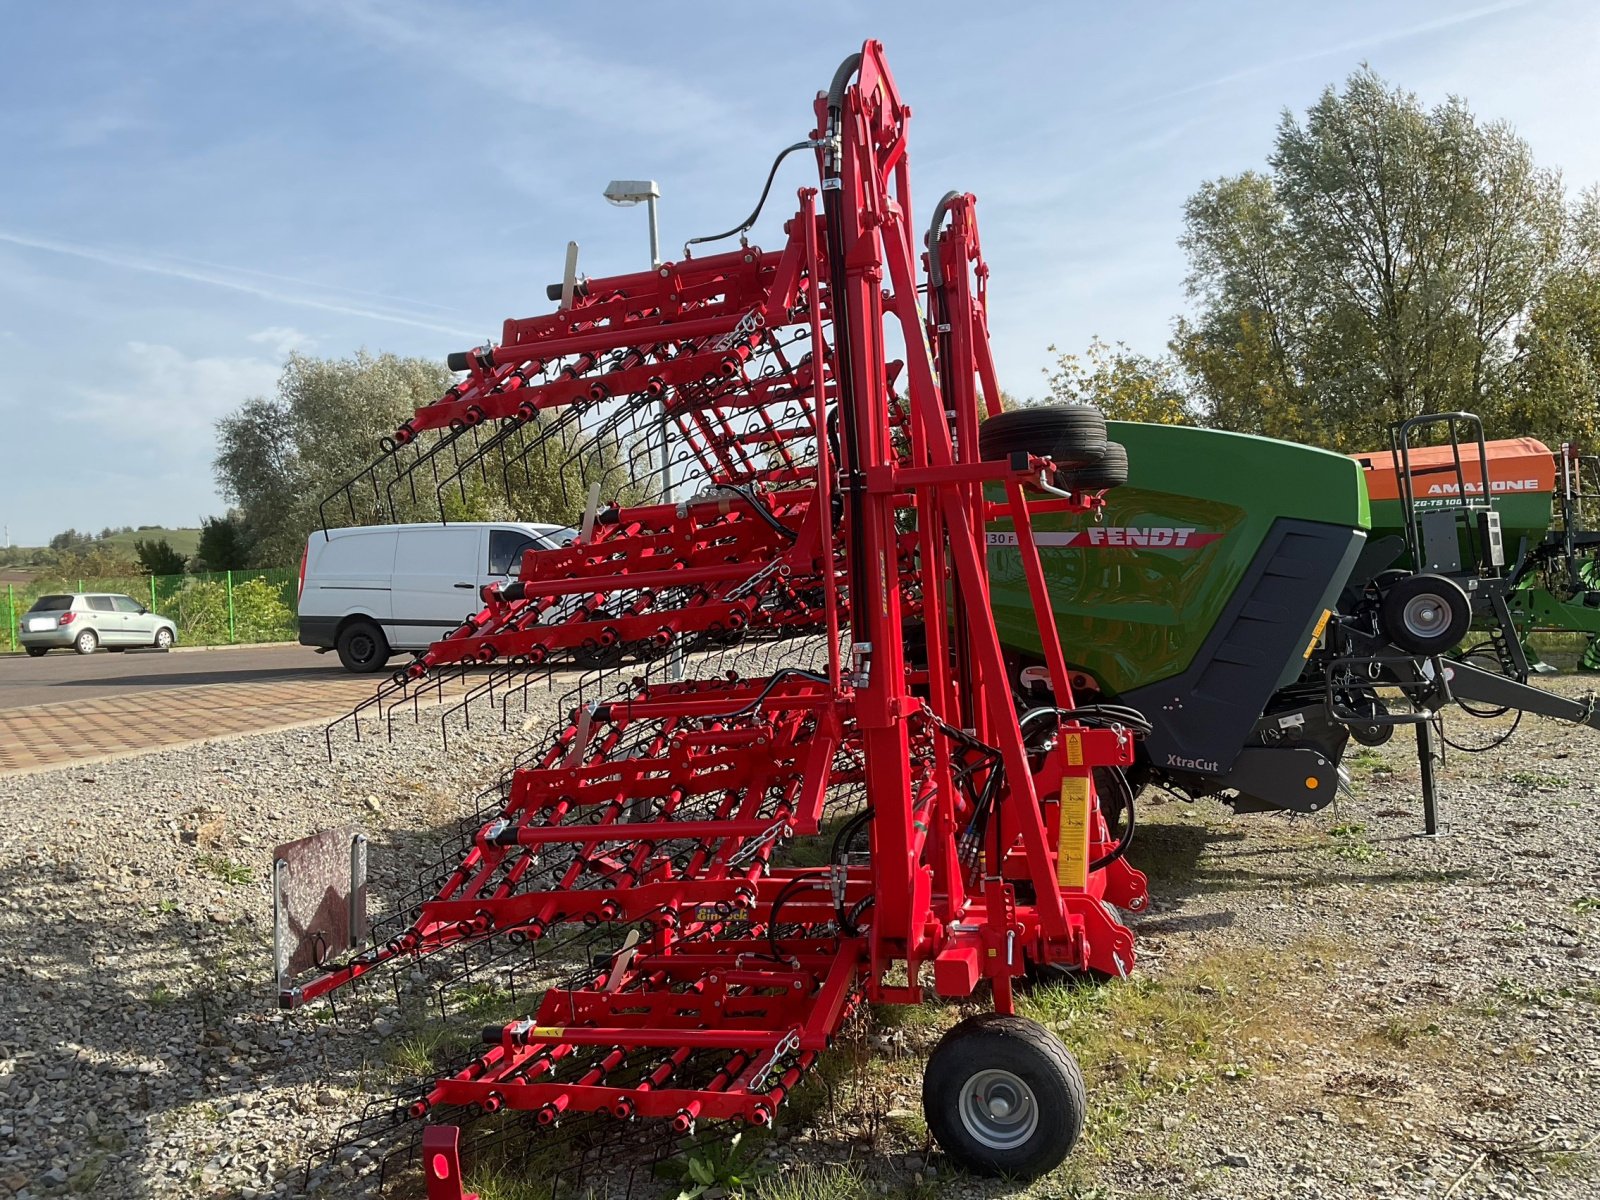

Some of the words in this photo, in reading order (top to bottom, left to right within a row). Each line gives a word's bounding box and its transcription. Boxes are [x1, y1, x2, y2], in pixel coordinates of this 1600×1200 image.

[1008, 535, 1014, 544] F
[1087, 527, 1196, 546] FENDT
[1167, 754, 1219, 772] XtraCut
